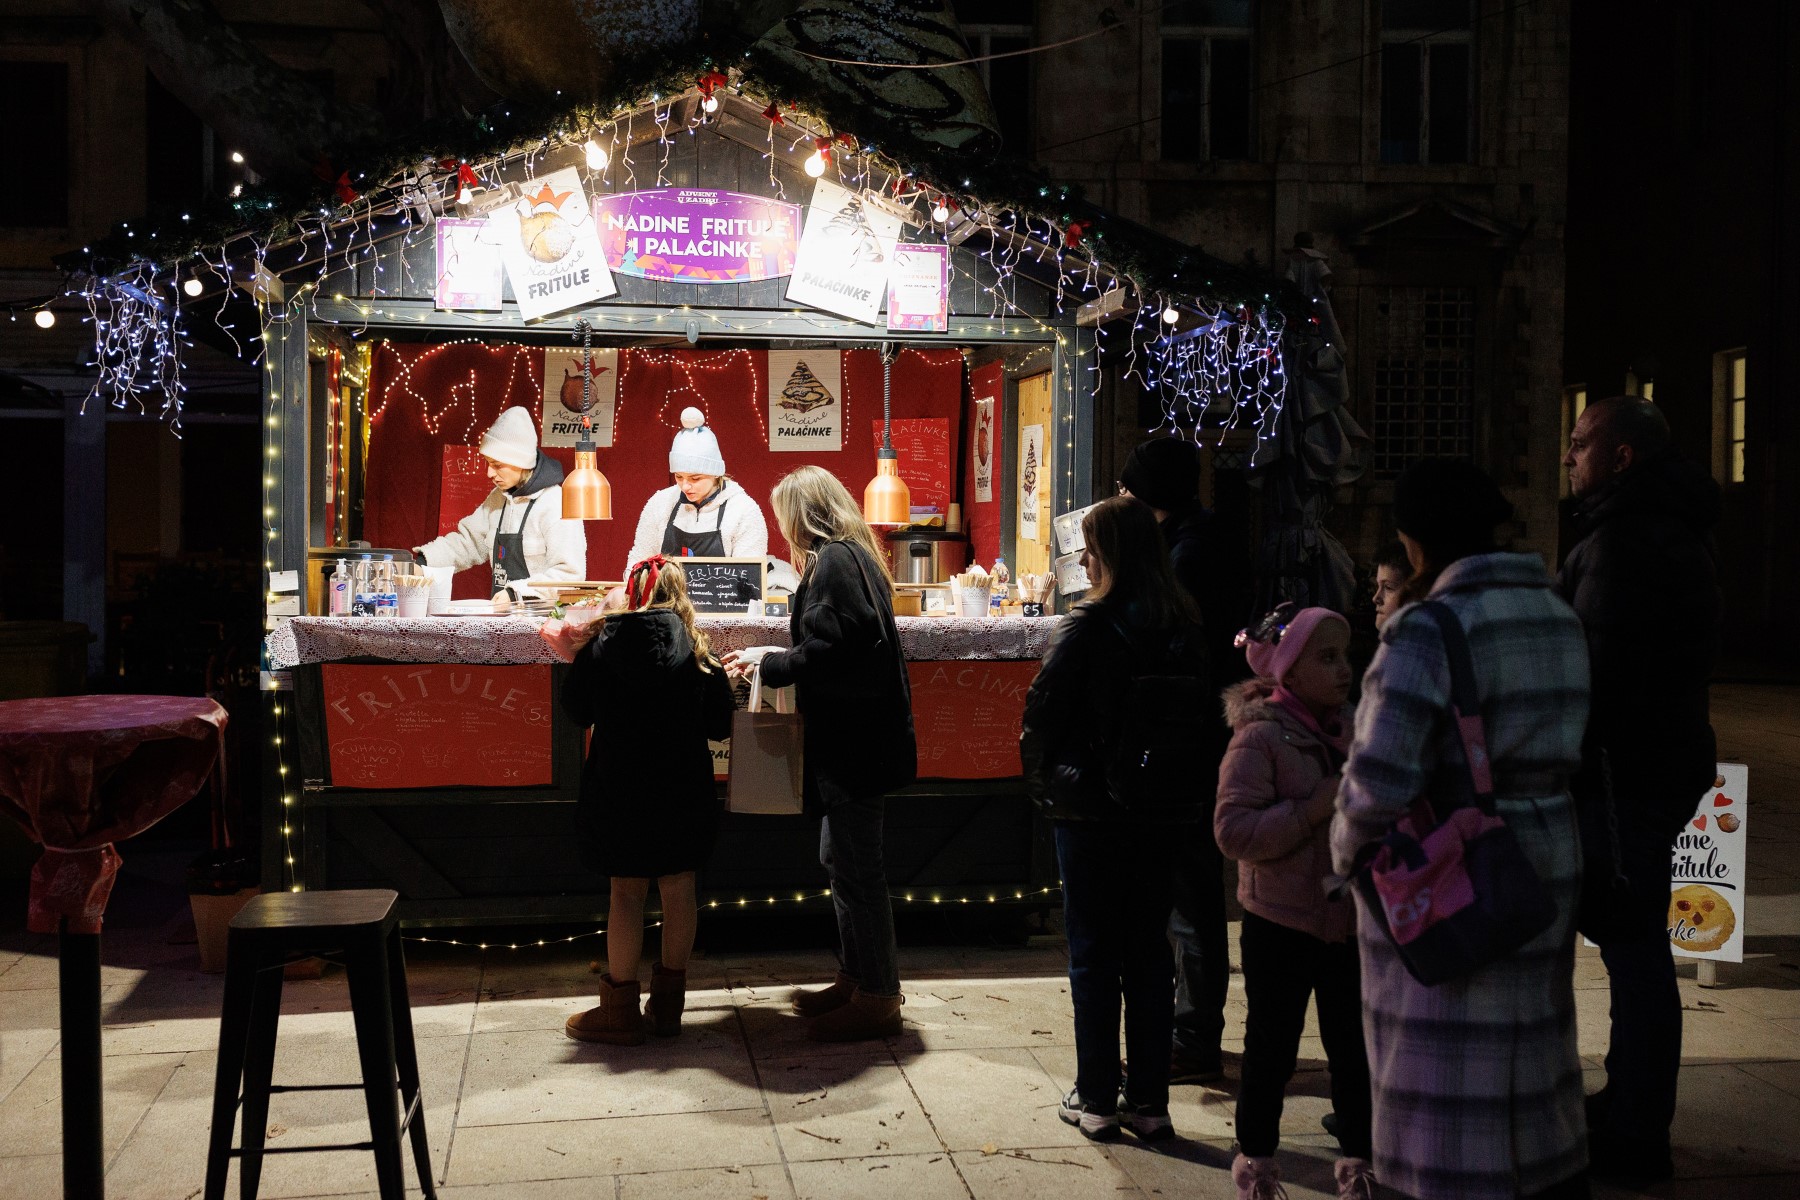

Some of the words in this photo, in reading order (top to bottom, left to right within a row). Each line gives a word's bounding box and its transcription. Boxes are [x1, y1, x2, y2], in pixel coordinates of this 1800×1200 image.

[678, 190, 718, 198] ADVENT
[607, 214, 690, 234] NADINE
[702, 217, 788, 239] FRITULE
[632, 237, 639, 254] I
[645, 234, 763, 259] PALAČINKE
[523, 249, 585, 277] Nadine
[528, 268, 590, 300] FRITULE
[801, 271, 871, 302] PALAČINKE
[778, 411, 828, 425] Nadine
[777, 425, 832, 437] PALAČINKE
[688, 564, 748, 580] FRITULE
[1023, 604, 1040, 617] €5
[330, 668, 528, 726] FRITULE
[337, 744, 397, 756] KUHANO
[352, 753, 389, 764] VINO
